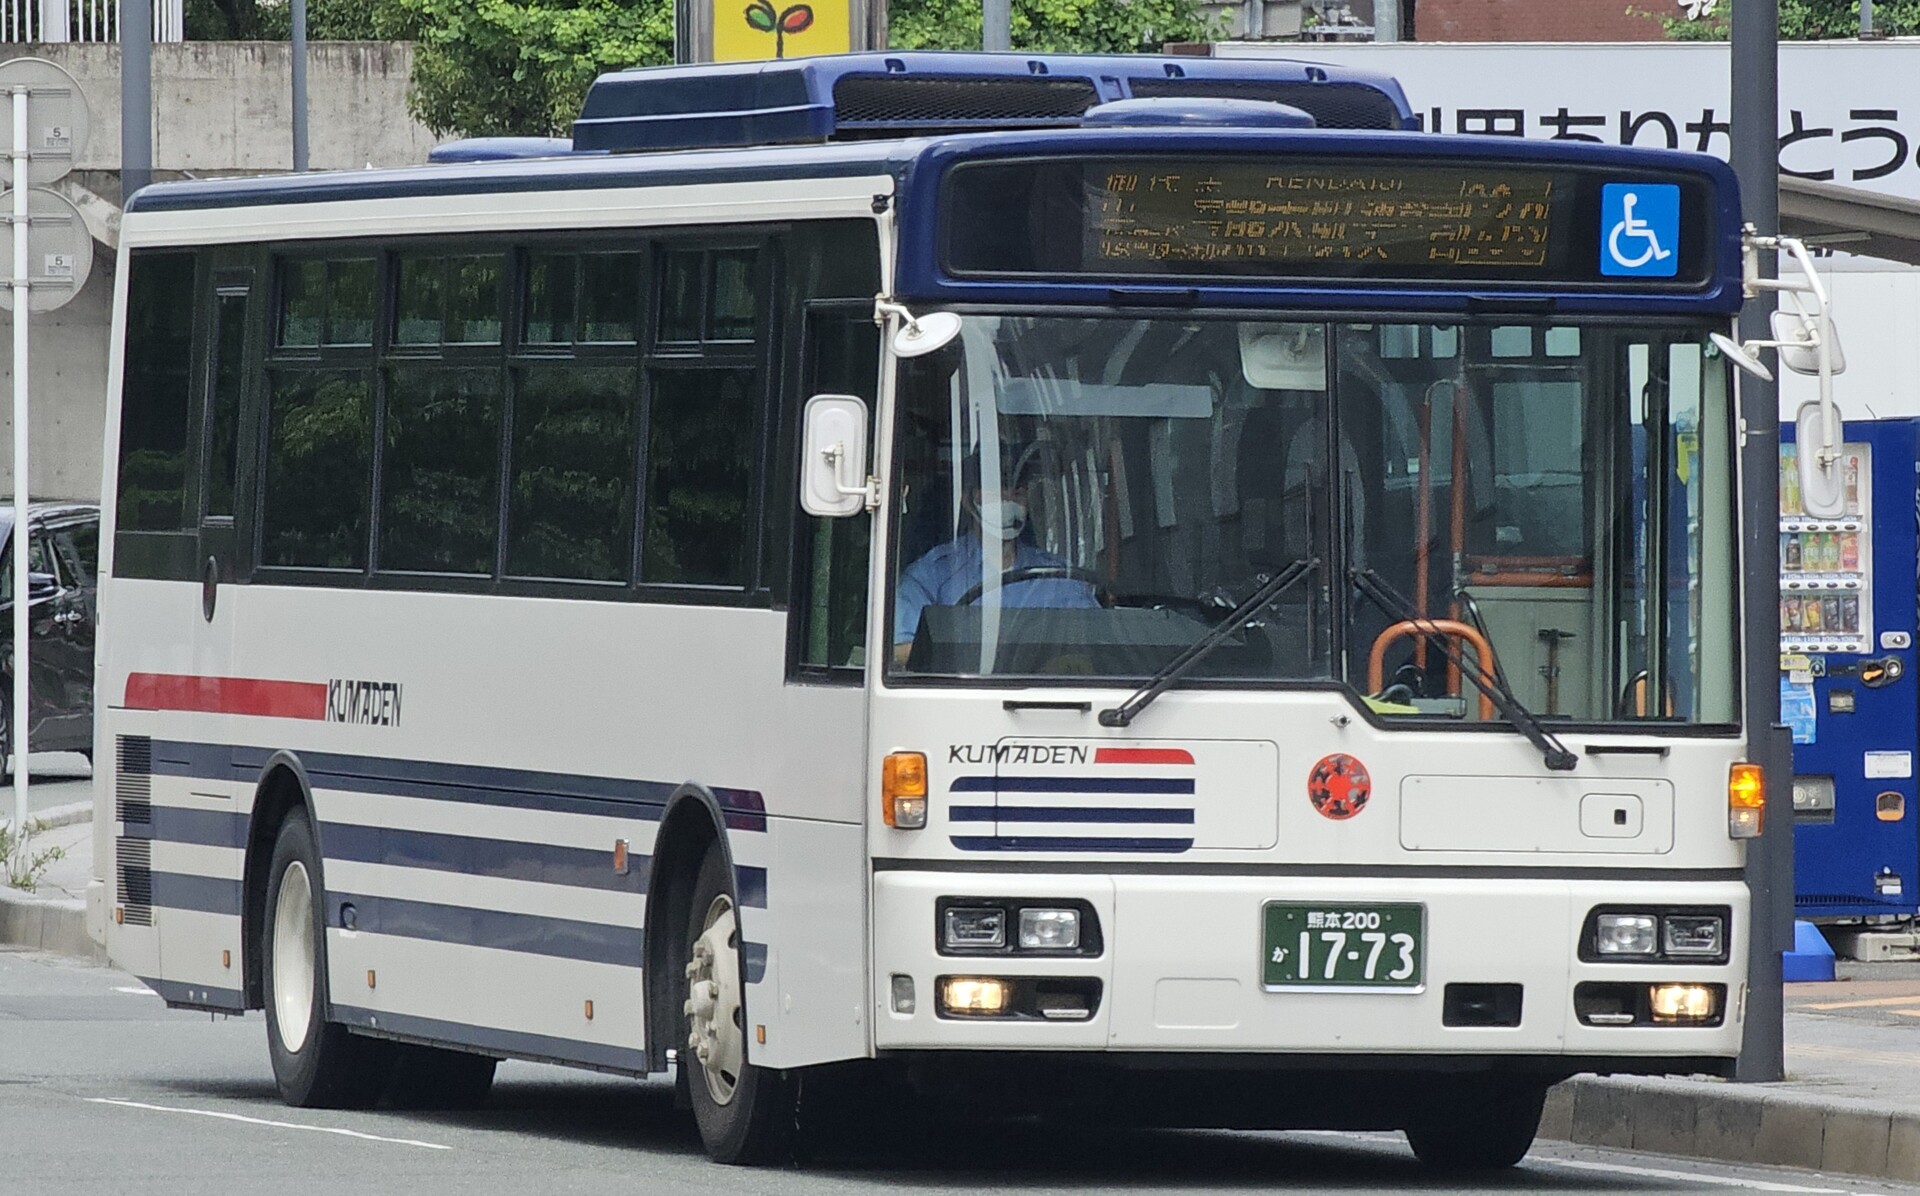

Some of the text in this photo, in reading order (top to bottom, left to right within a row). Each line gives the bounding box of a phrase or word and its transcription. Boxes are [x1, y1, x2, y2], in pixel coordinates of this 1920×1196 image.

[327, 678, 403, 728] KUMADEN
[948, 744, 1089, 765] KUMADEN
[1271, 931, 1415, 980] か 17-73
